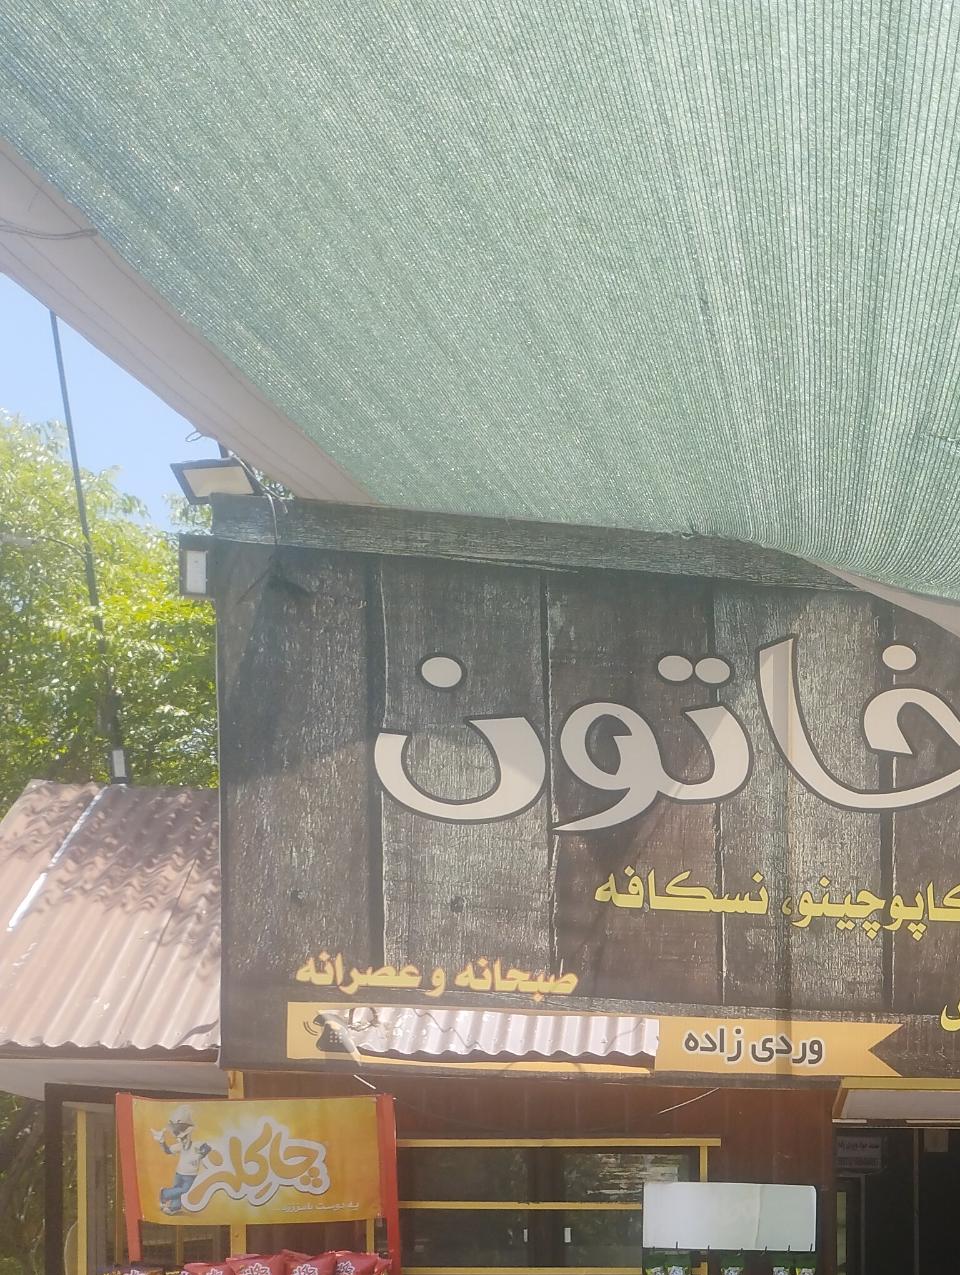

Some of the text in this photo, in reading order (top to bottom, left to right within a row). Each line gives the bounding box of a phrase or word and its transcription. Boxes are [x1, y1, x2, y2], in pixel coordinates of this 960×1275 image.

[594, 864, 769, 916] نسکافه
[295, 949, 580, 1003] صبحانه و عصرانه
[683, 1027, 824, 1065] وردی زاده
[183, 1118, 329, 1209] چاکلز
